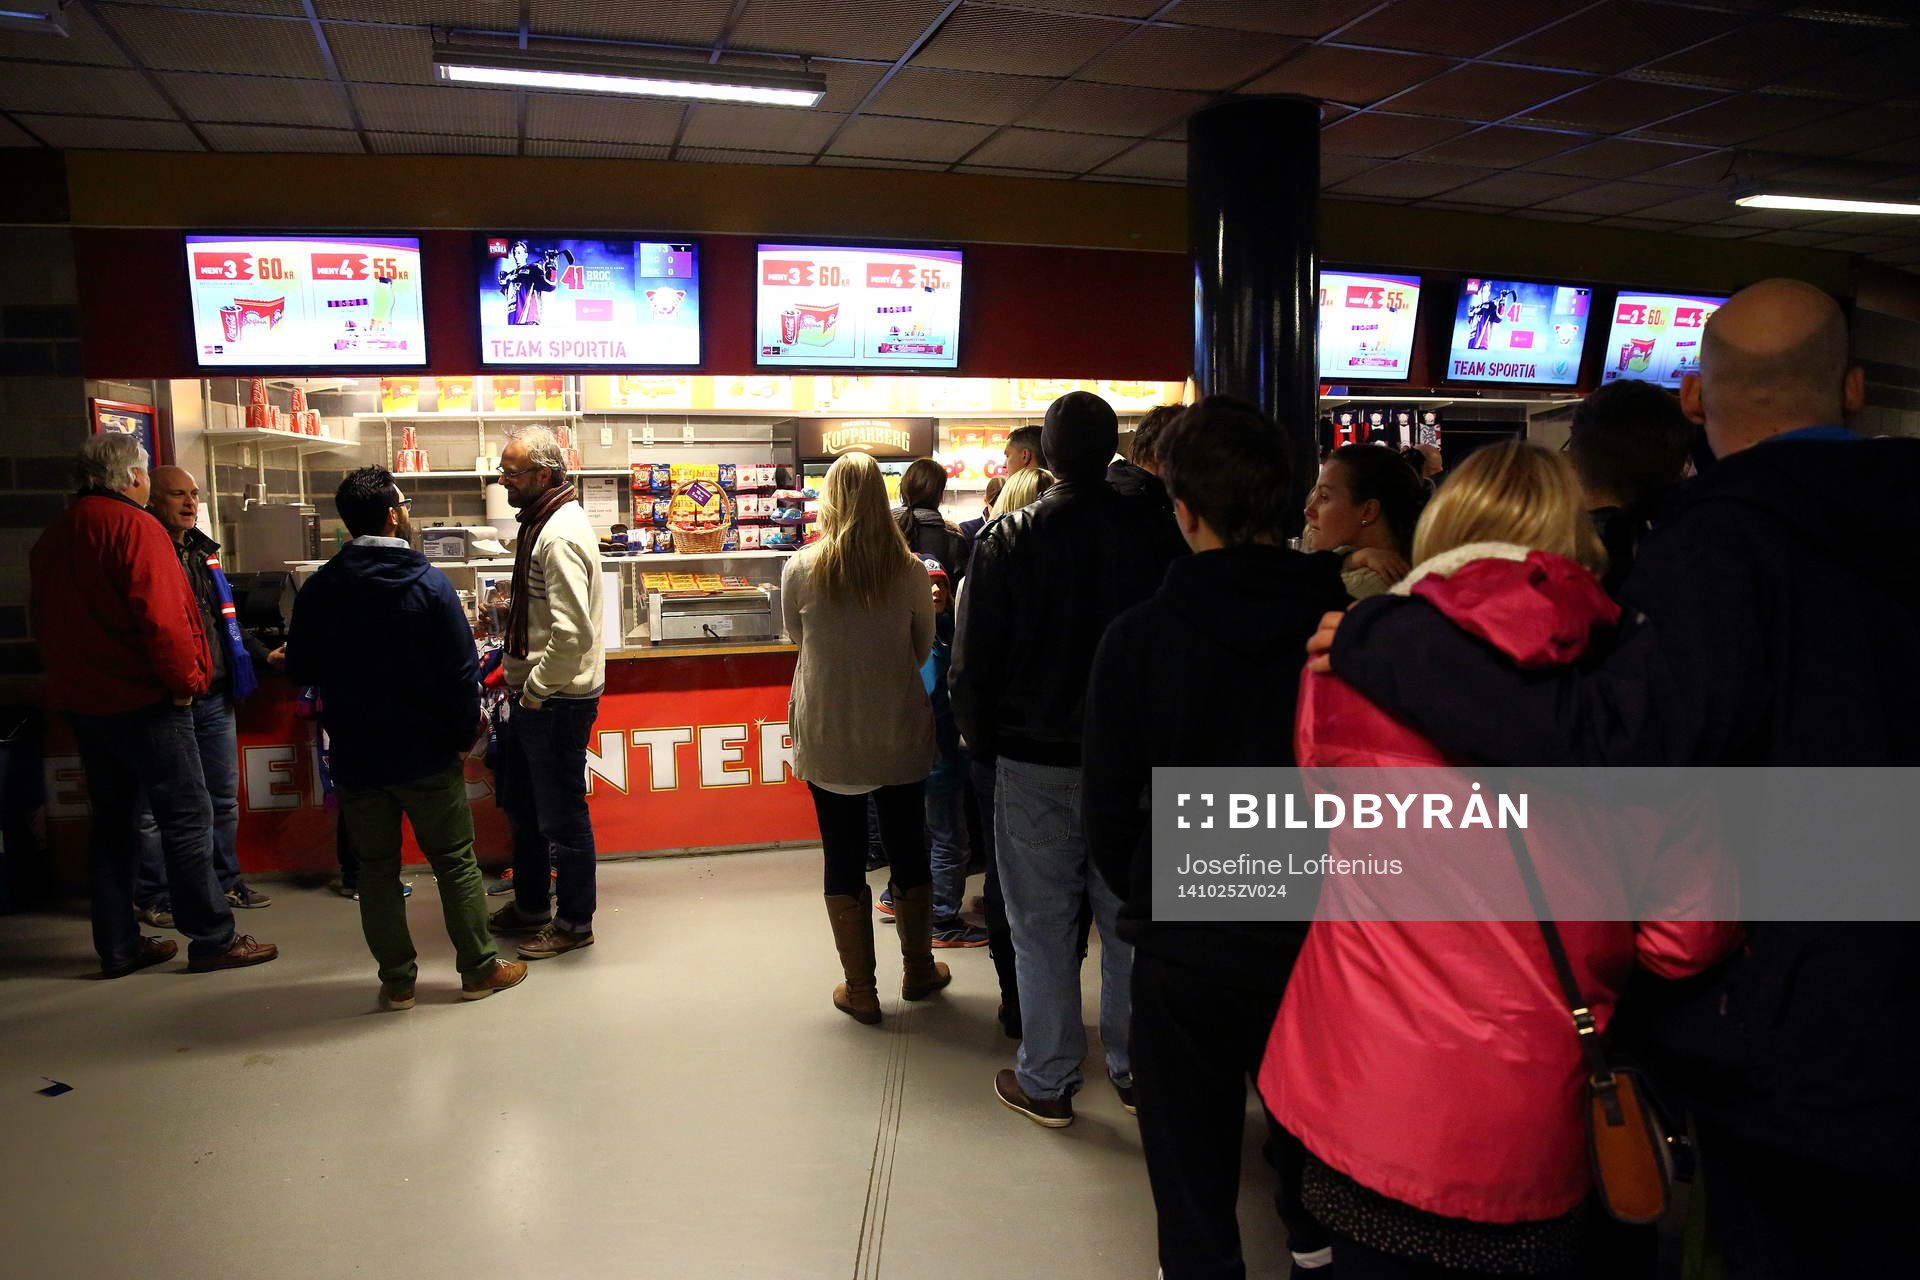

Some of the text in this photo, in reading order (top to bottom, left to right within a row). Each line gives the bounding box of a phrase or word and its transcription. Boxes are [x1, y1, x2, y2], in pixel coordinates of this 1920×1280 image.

[200, 266, 223, 275] MENY
[222, 259, 238, 279] 3
[258, 257, 283, 280] 60
[317, 266, 340, 275] MENY
[338, 259, 354, 279] 4
[373, 258, 397, 280] 55
[667, 256, 674, 264] 0
[560, 266, 585, 290] 41
[586, 270, 611, 281] BROC
[667, 268, 674, 276] 0
[787, 267, 801, 285] 3
[819, 266, 841, 287] 60
[890, 268, 904, 287] 4
[920, 269, 941, 289] 55
[1363, 291, 1375, 308] 4
[1386, 291, 1404, 310] 55
[1507, 303, 1522, 323] 41
[1630, 309, 1640, 324] 3
[1647, 309, 1662, 325] 60
[490, 340, 627, 358] TEAM SPORTIA
[1454, 360, 1536, 379] TEAM SPORTIA
[822, 426, 911, 454] KOPPARBERG
